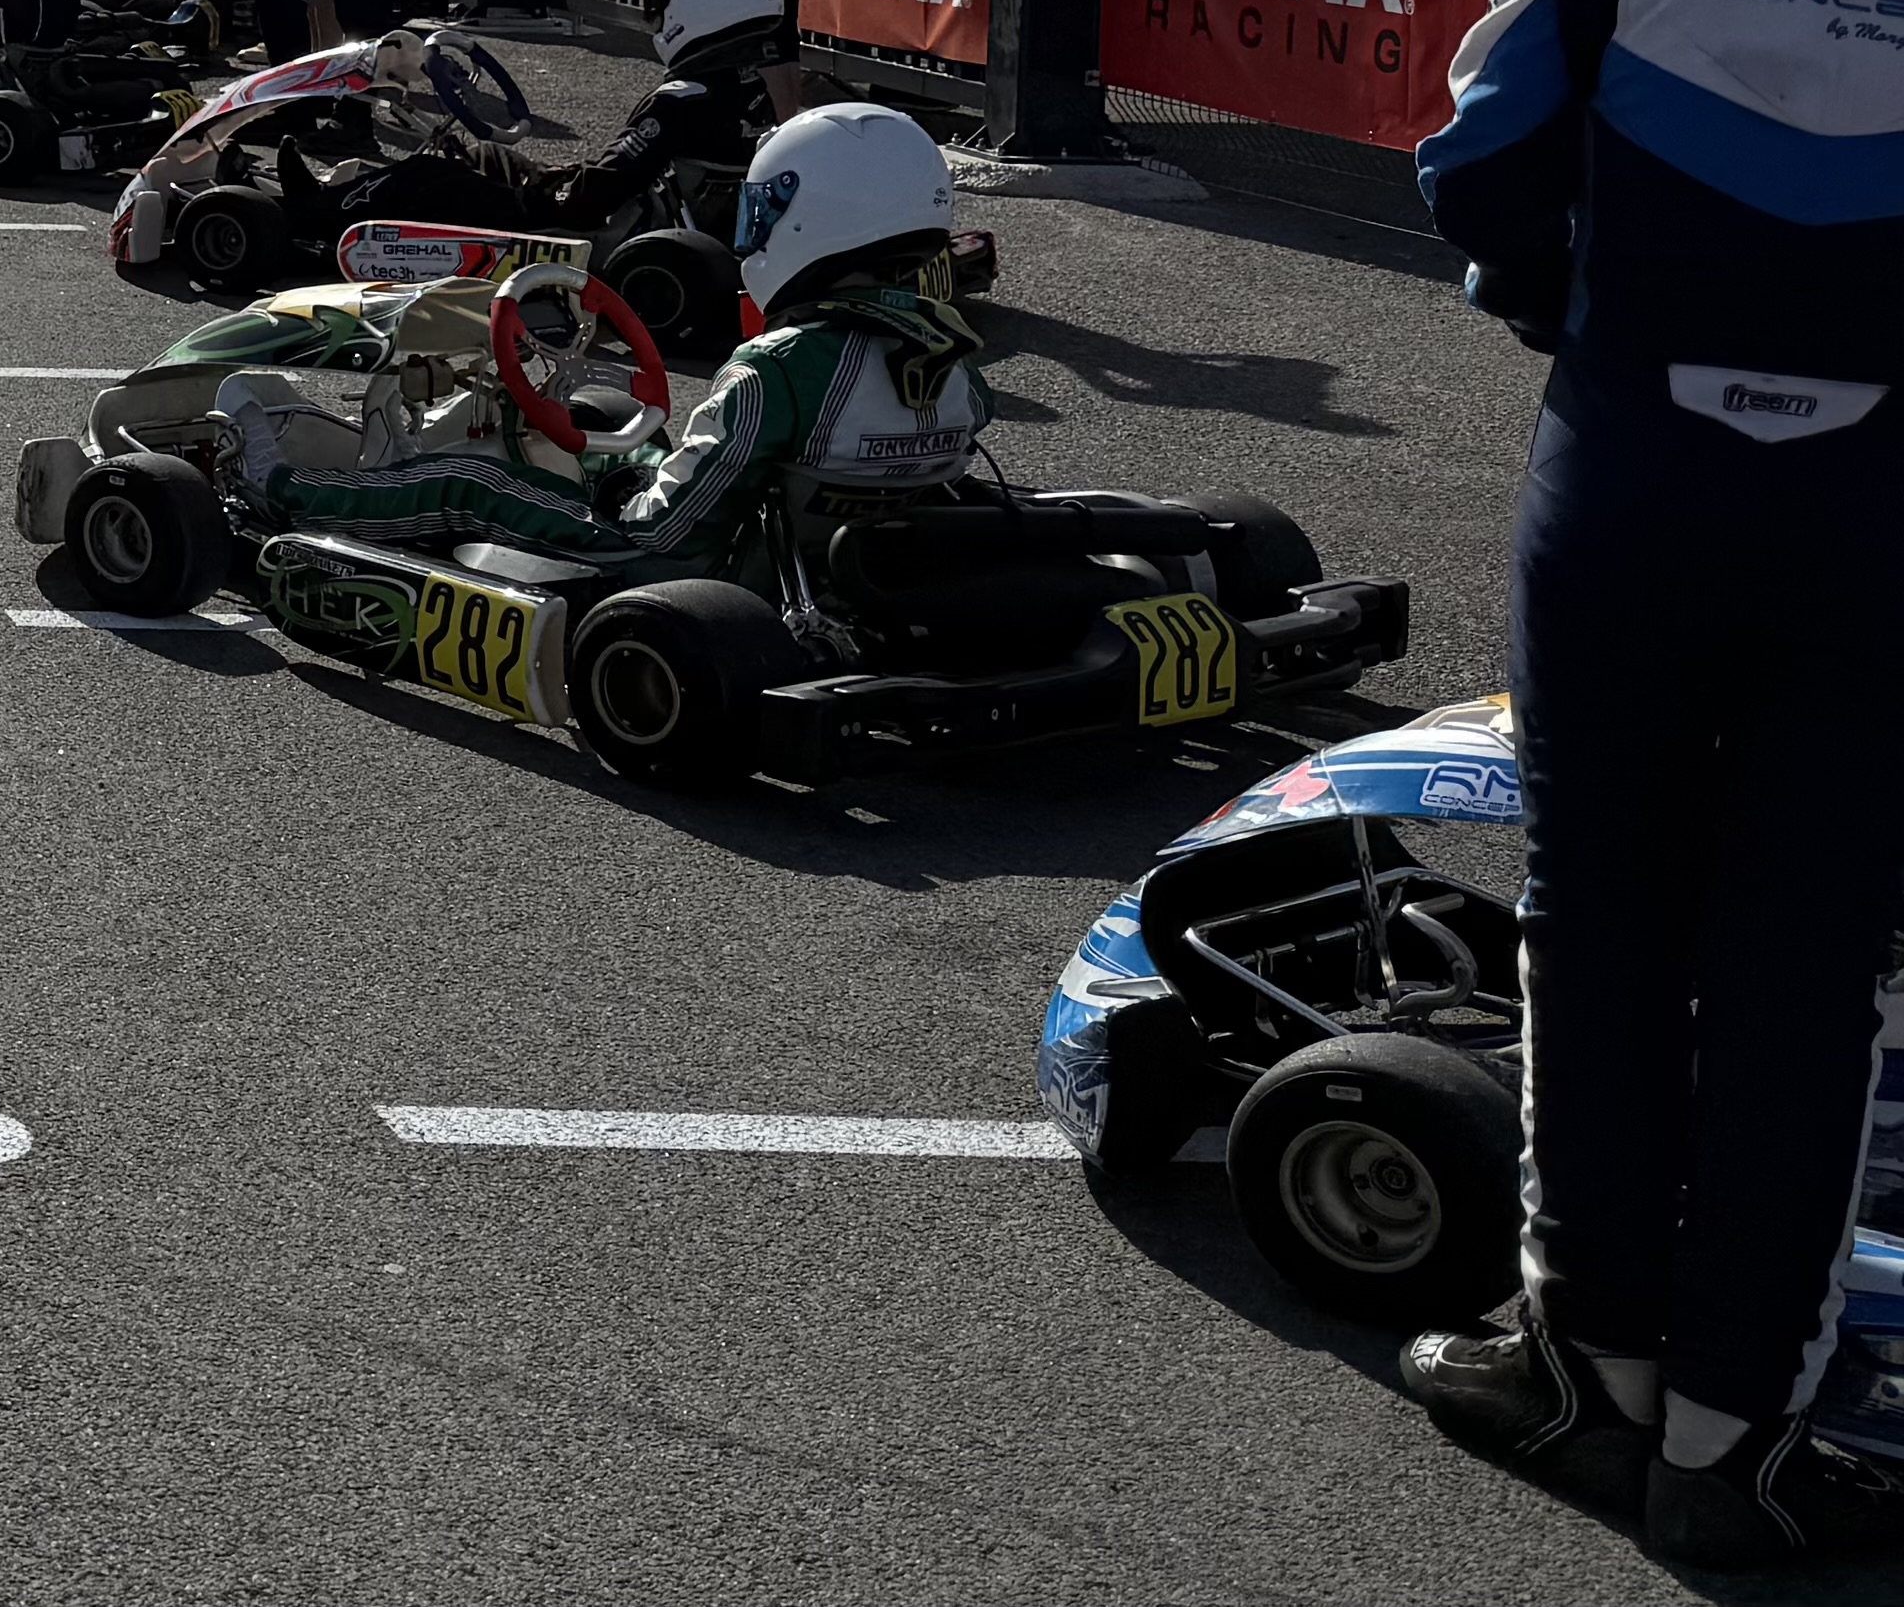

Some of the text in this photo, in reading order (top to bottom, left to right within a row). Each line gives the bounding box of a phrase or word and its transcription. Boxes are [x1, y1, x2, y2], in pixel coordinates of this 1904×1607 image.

[371, 264, 415, 281] tec3h
[383, 244, 452, 257] GREHAL
[423, 581, 526, 714] 282
[1123, 598, 1231, 717] 282
